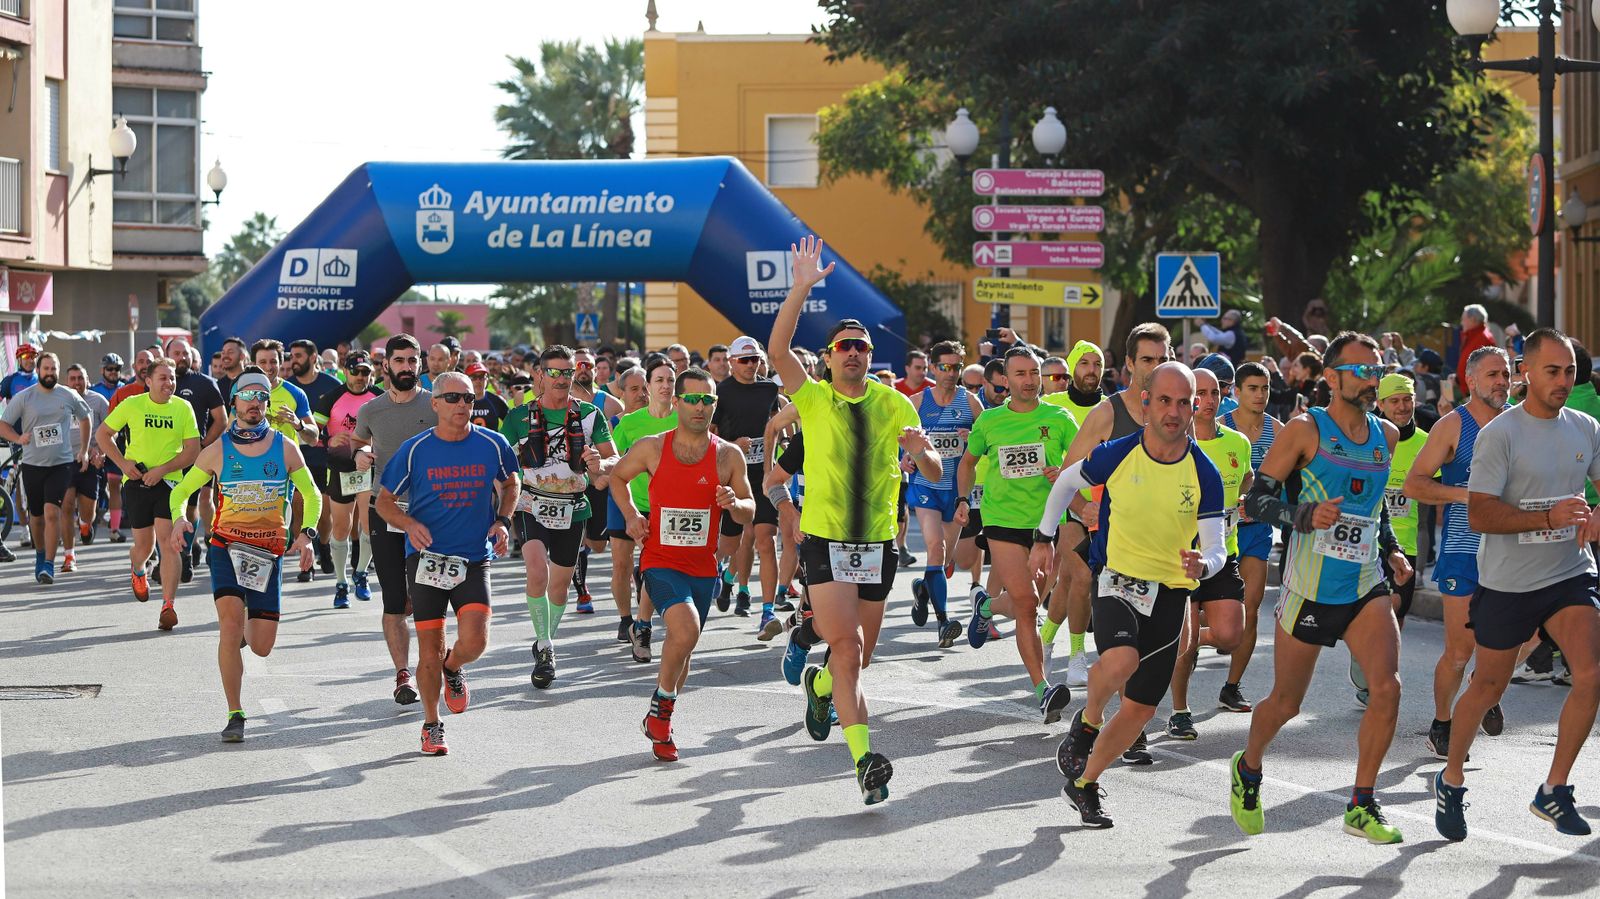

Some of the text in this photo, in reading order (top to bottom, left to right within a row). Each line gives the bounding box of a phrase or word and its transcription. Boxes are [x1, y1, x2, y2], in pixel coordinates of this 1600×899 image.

[462, 190, 675, 221] Ayuntamiento
[487, 223, 652, 248] de La Línea
[289, 257, 309, 277] D
[757, 260, 776, 282] D
[278, 286, 341, 295] DELEGACIÓN DE
[977, 280, 1043, 292] Ayuntamiento
[976, 291, 993, 299] City
[277, 296, 354, 311] DEPORTES
[144, 418, 174, 429] RUN
[38, 429, 59, 438] 139
[934, 438, 959, 448] 300
[1006, 451, 1039, 466] 238
[427, 464, 486, 480] FINISHER
[349, 475, 363, 485] 83
[539, 504, 566, 517] 281
[669, 517, 702, 532] 125
[1334, 524, 1362, 544] 68
[849, 553, 862, 568] 8
[240, 560, 260, 577] 82
[425, 560, 459, 577] 315
